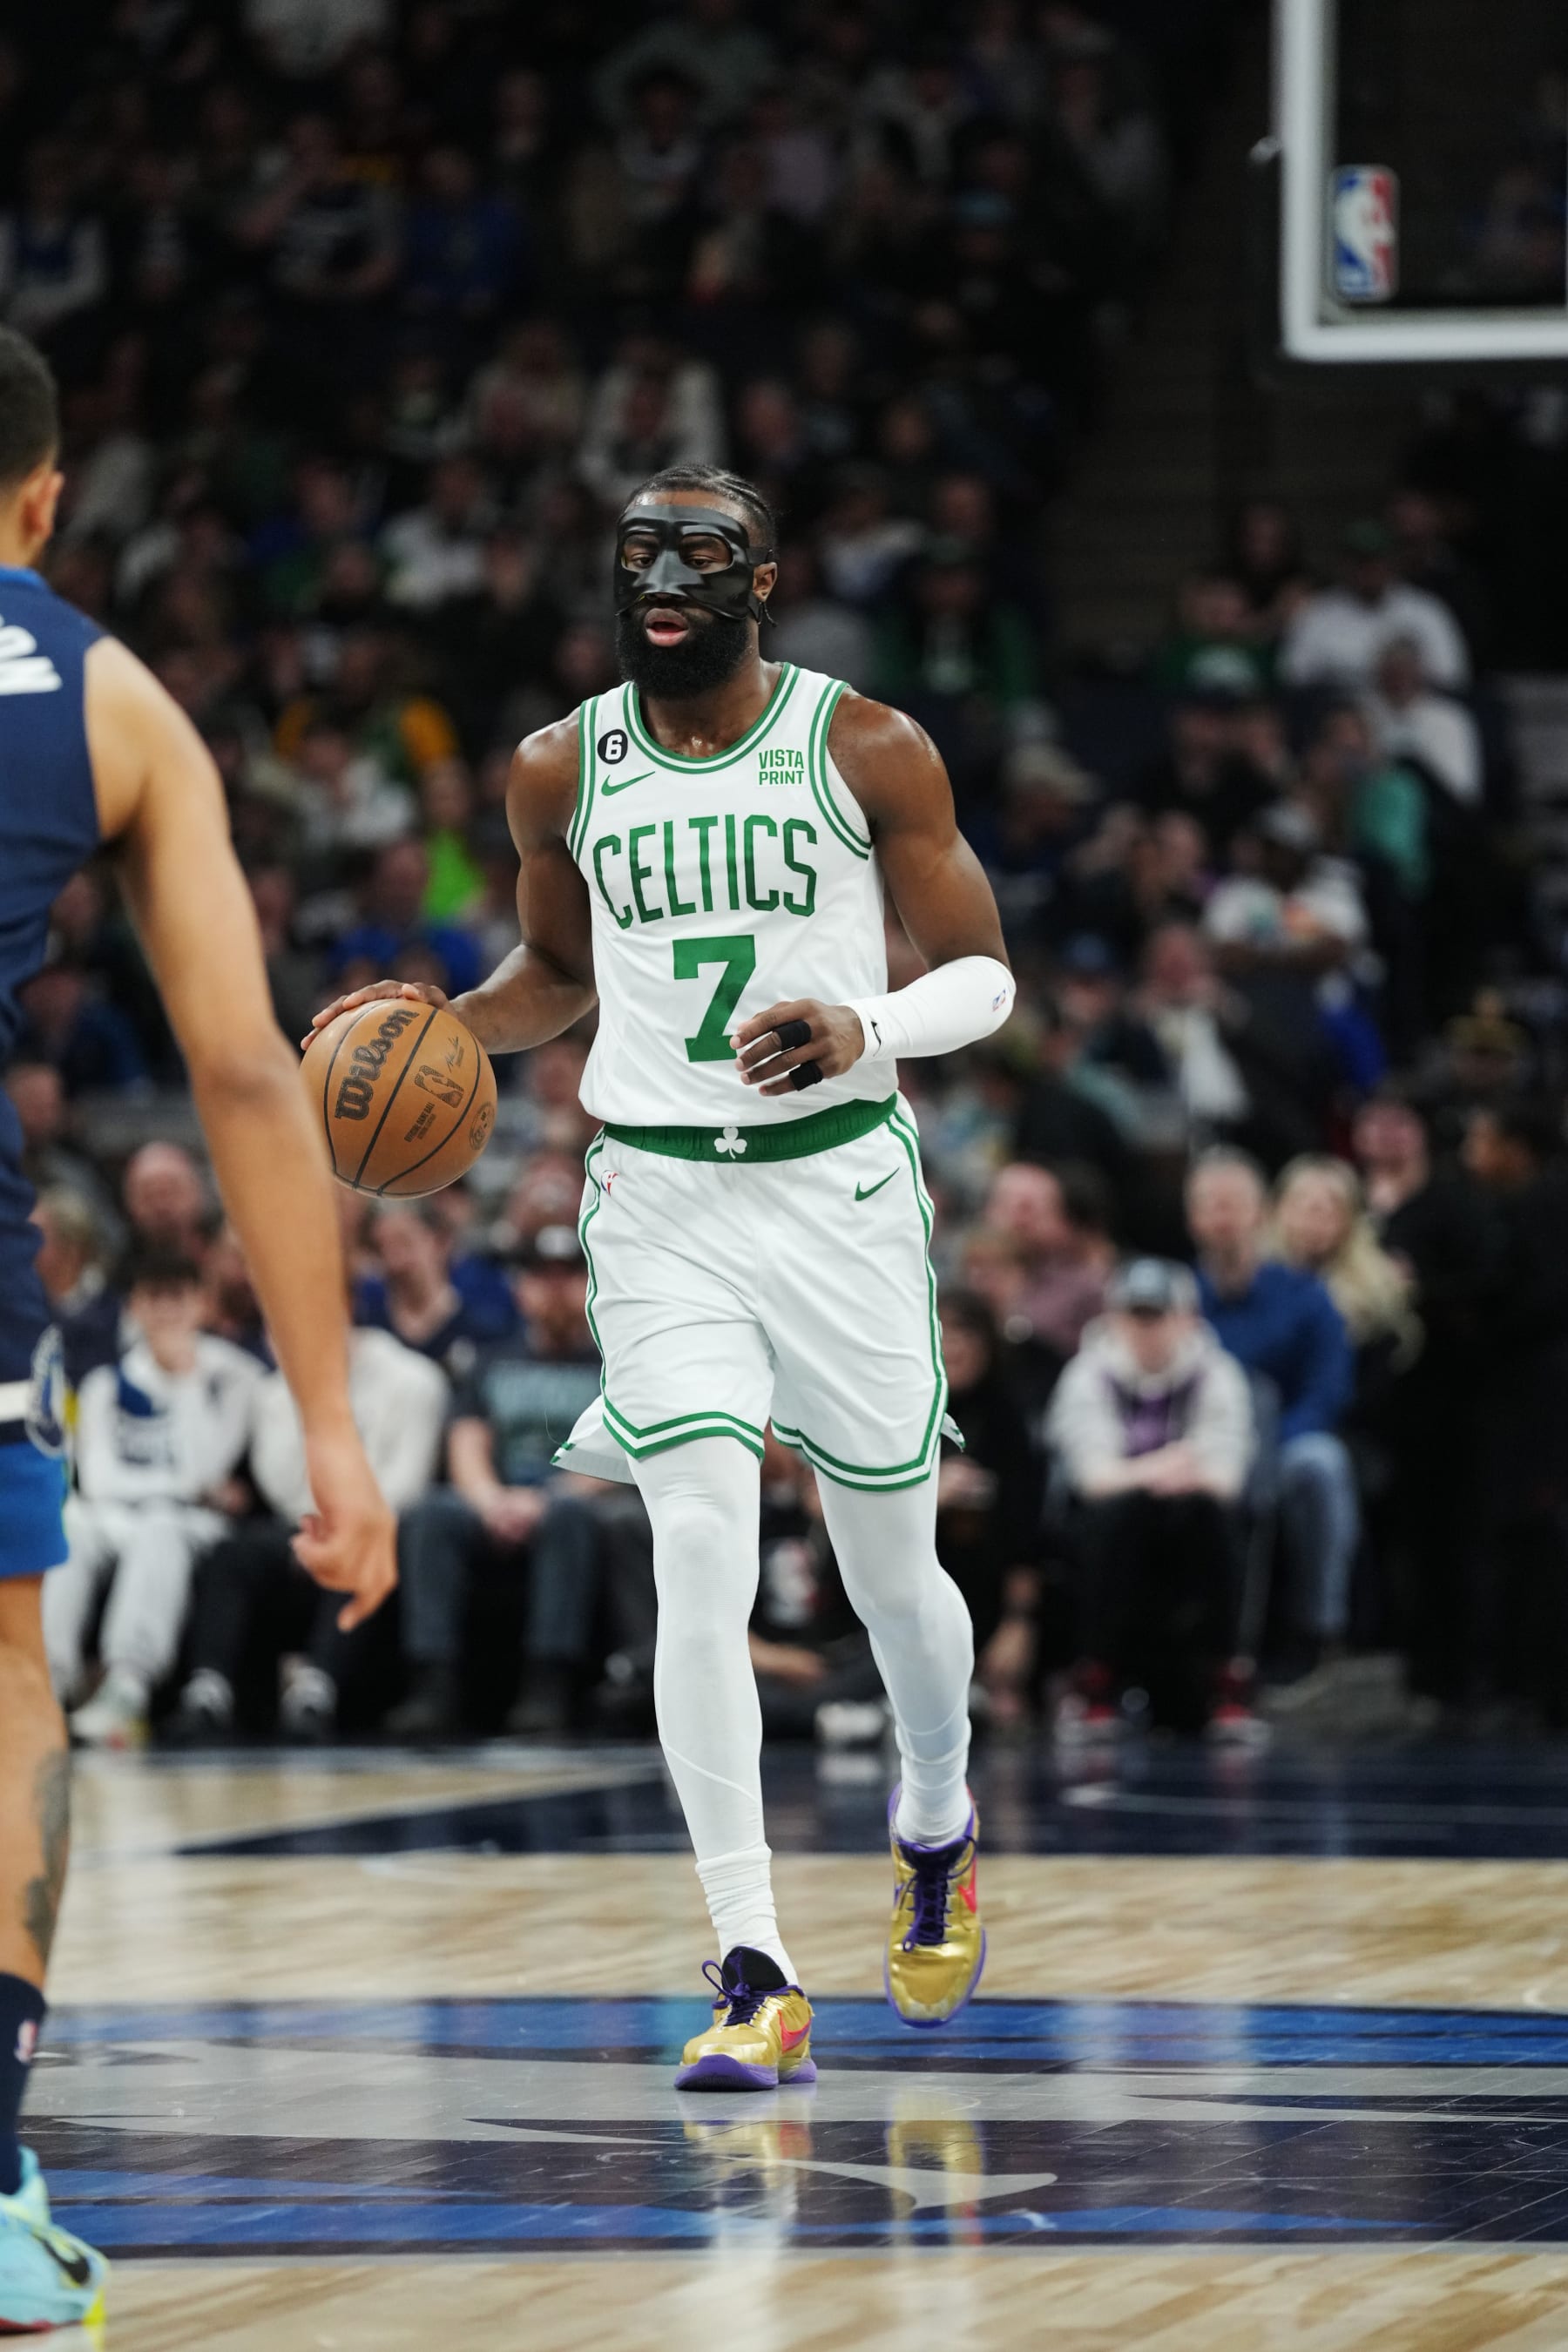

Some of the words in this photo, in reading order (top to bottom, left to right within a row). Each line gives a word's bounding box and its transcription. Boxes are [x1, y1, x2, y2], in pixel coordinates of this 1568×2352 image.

[605, 733, 623, 760] 6
[759, 748, 805, 769] VISTA
[759, 770, 805, 786] PRINT
[592, 814, 818, 929] CELTICS
[672, 934, 756, 1063] 7
[334, 1008, 420, 1121] Wilson
